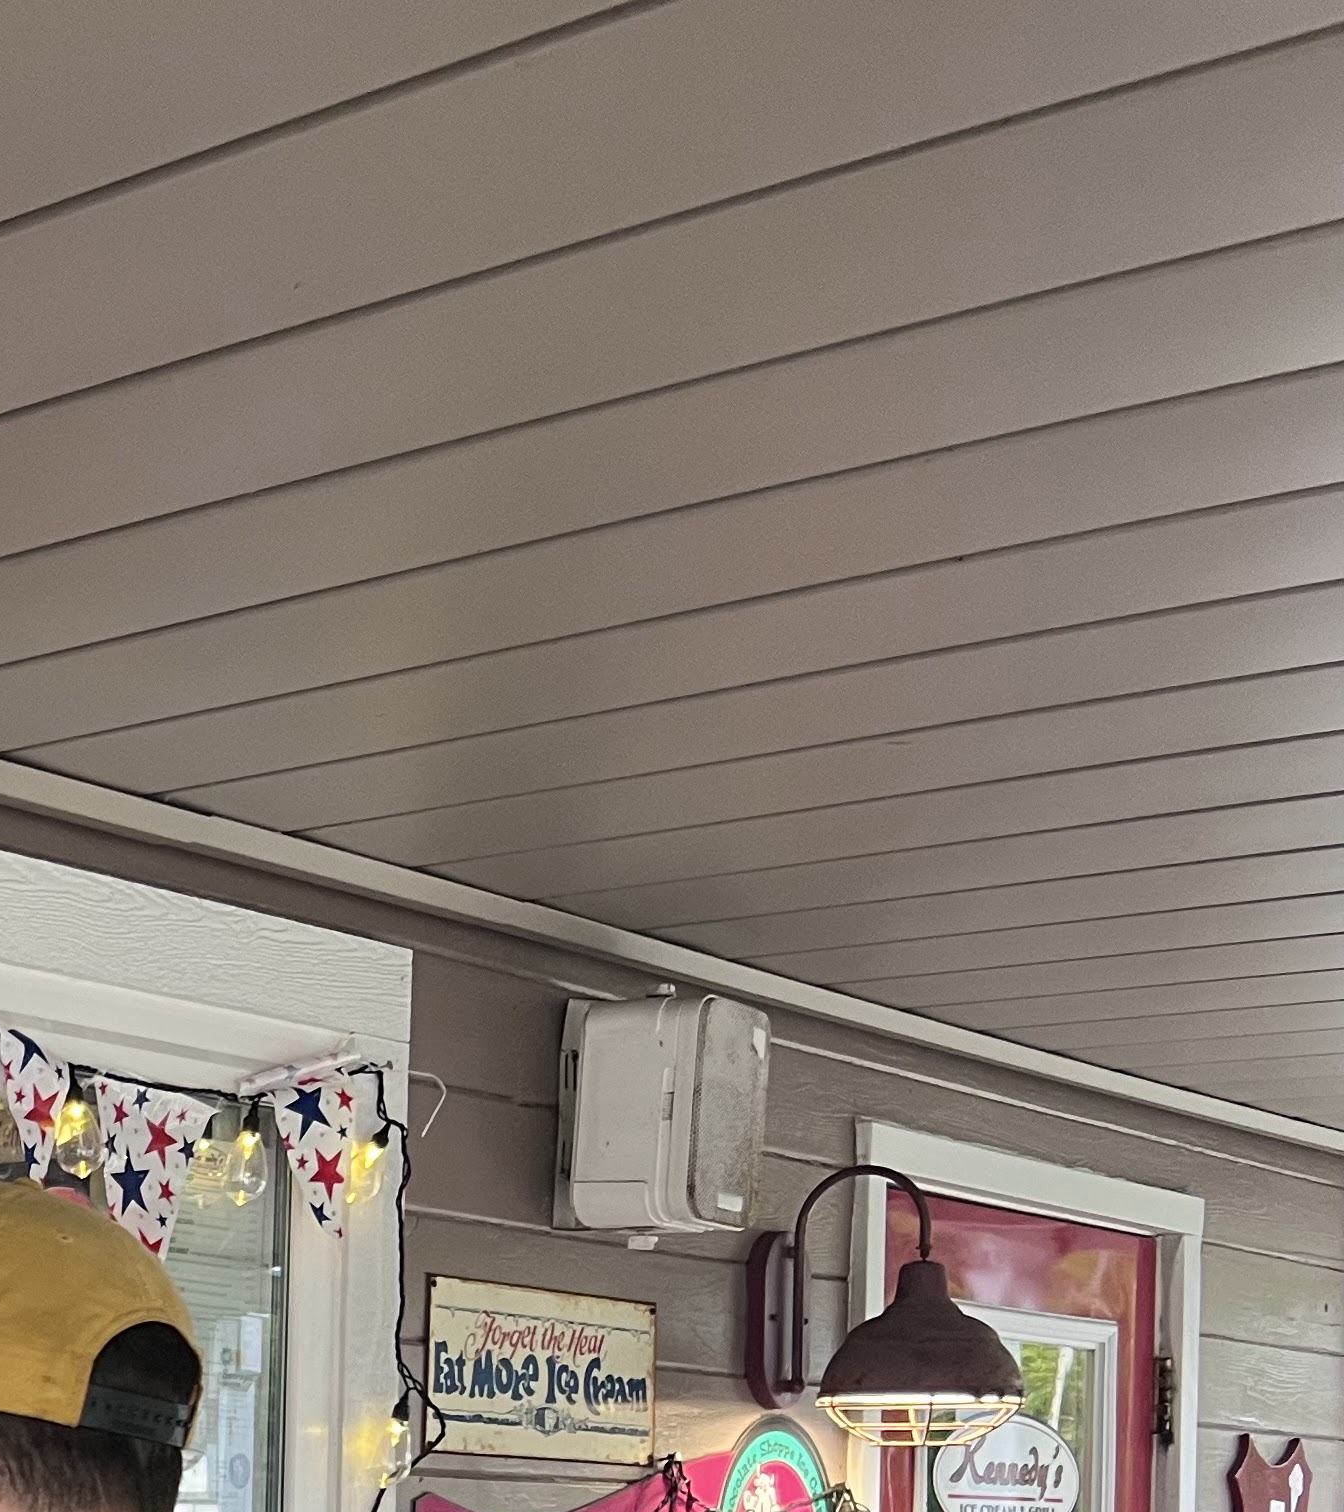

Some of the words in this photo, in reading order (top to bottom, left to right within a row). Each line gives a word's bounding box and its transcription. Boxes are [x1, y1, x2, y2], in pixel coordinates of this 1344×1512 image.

[474, 1310, 537, 1360] Forget
[541, 1322, 565, 1352] the
[433, 1340, 466, 1395] Eat
[469, 1349, 539, 1400] More
[546, 1355, 579, 1405] Ice
[584, 1357, 648, 1416] Cream
[949, 1434, 1063, 1502] Kennedy's
